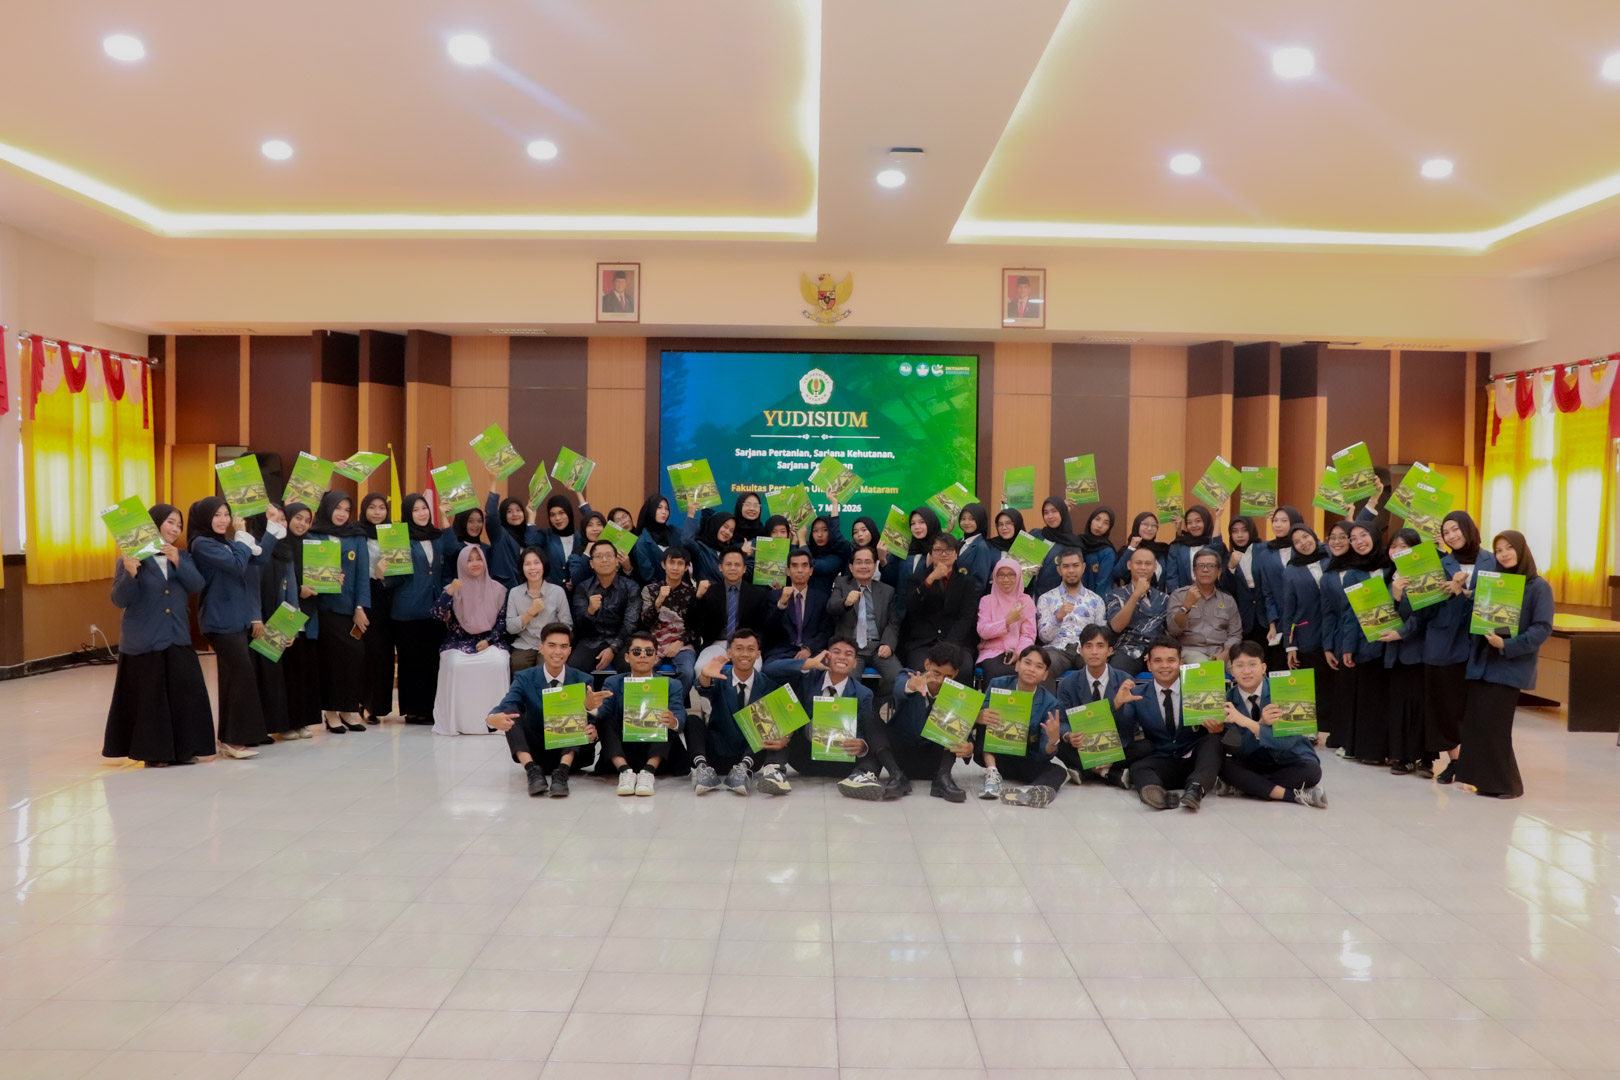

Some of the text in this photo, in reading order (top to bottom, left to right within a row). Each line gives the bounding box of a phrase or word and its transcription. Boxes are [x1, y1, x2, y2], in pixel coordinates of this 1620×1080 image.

[763, 410, 868, 428] YUDISIUM
[735, 448, 767, 458] Sarjana
[768, 448, 812, 458] Pertanian,
[847, 449, 895, 459] Kehutanan,
[777, 461, 809, 471] Sarjana
[731, 483, 767, 492] Fakultas
[860, 485, 899, 494] Mataram
[818, 504, 824, 512] 7
[825, 504, 841, 512] Mi
[842, 504, 862, 512] 2026
